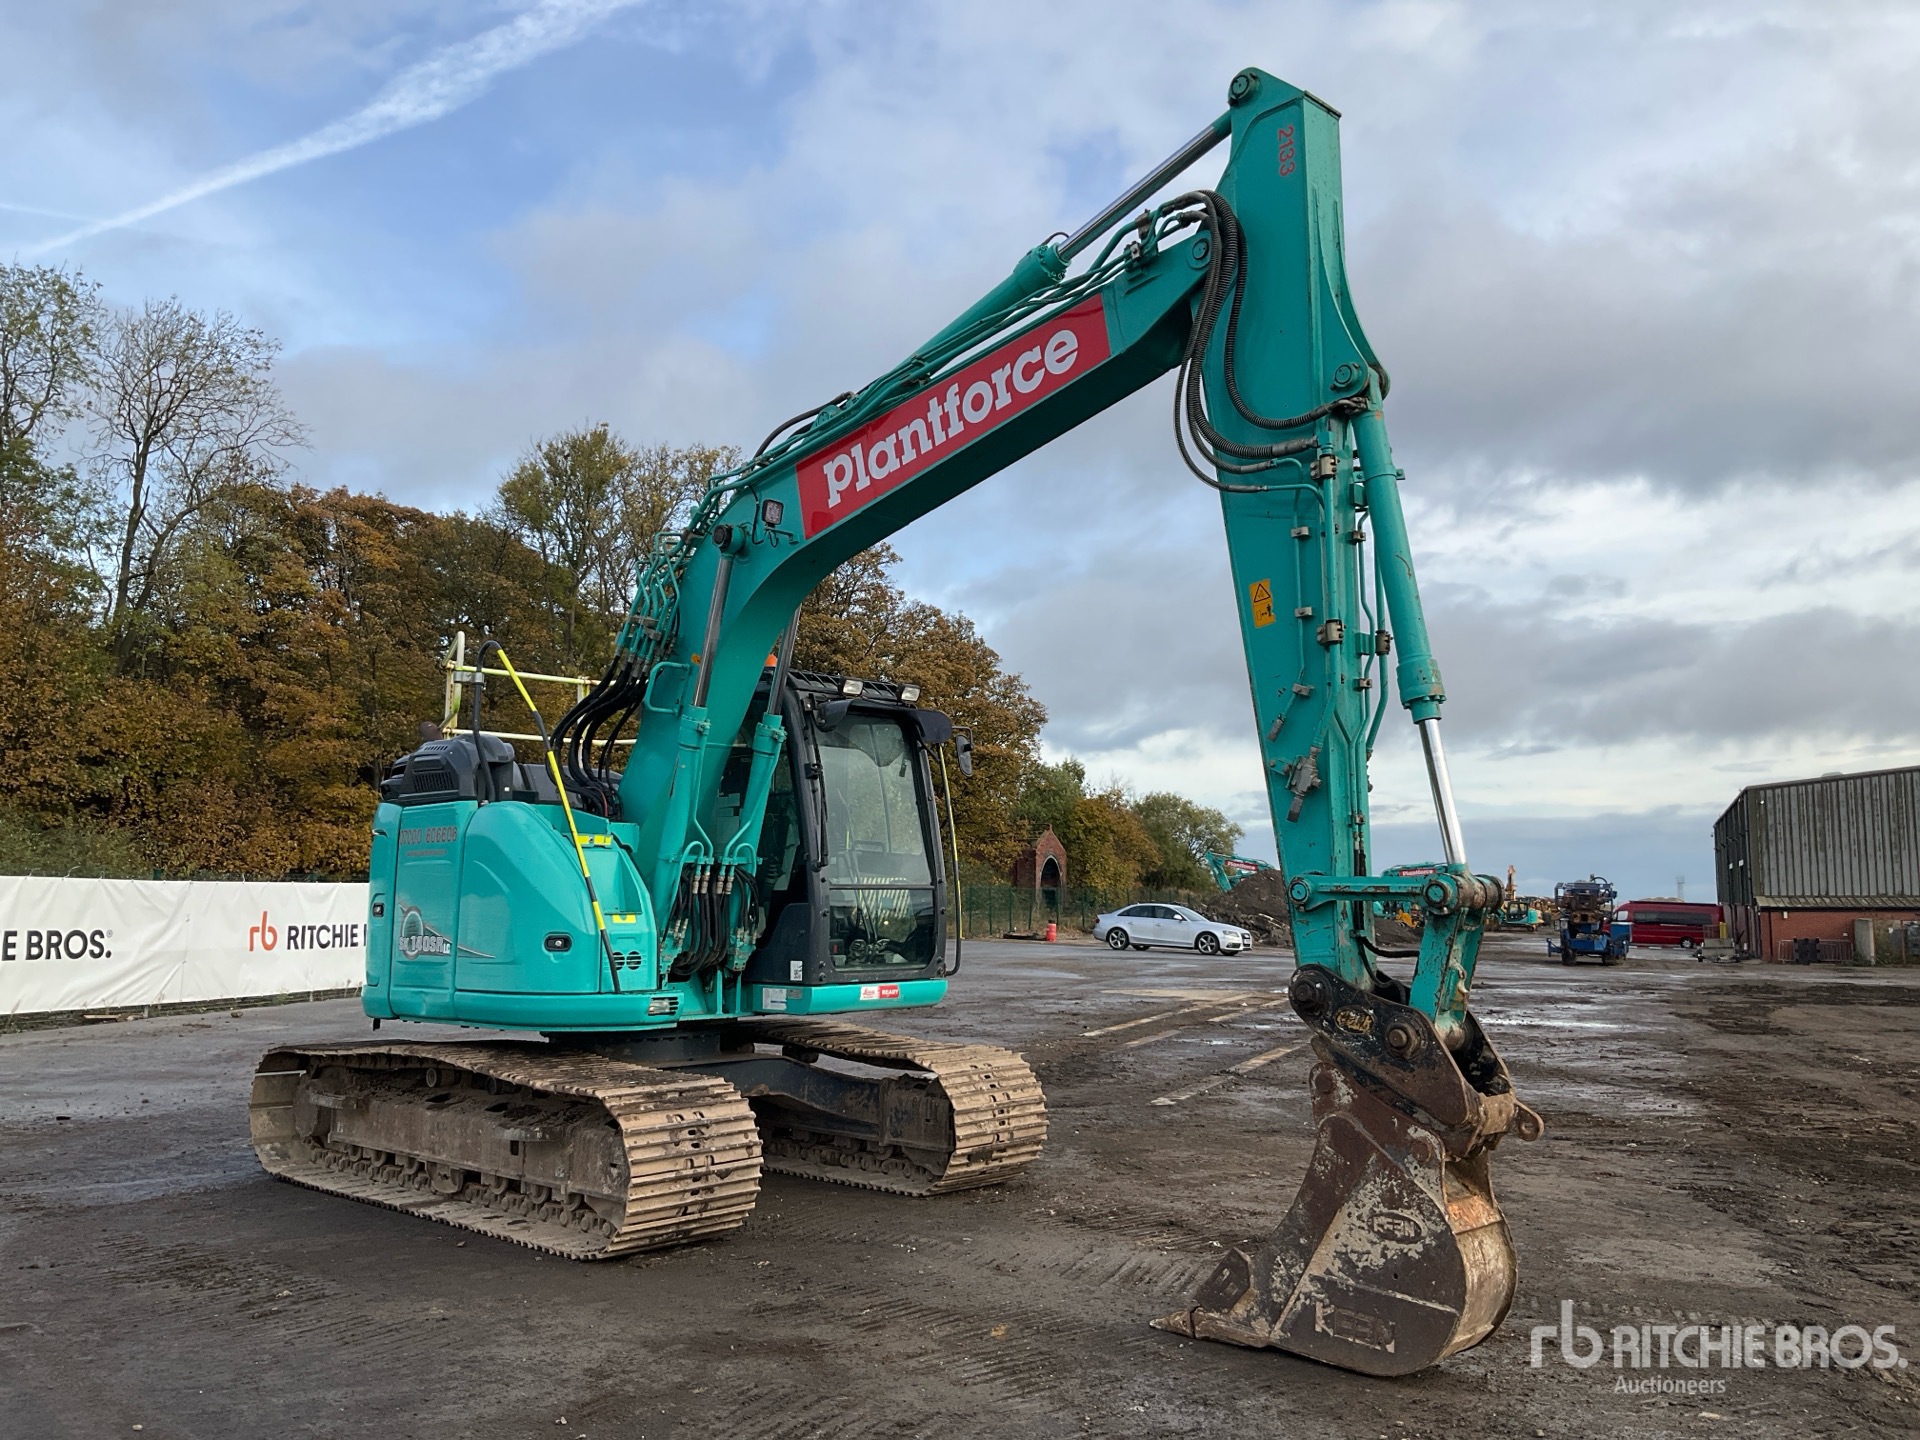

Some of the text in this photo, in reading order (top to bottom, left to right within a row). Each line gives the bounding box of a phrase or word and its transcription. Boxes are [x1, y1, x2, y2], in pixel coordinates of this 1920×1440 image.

[1278, 124, 1295, 176] 2133
[823, 329, 1079, 509] plantforce
[425, 826, 457, 843] 606606
[287, 924, 359, 950] RITCHIE
